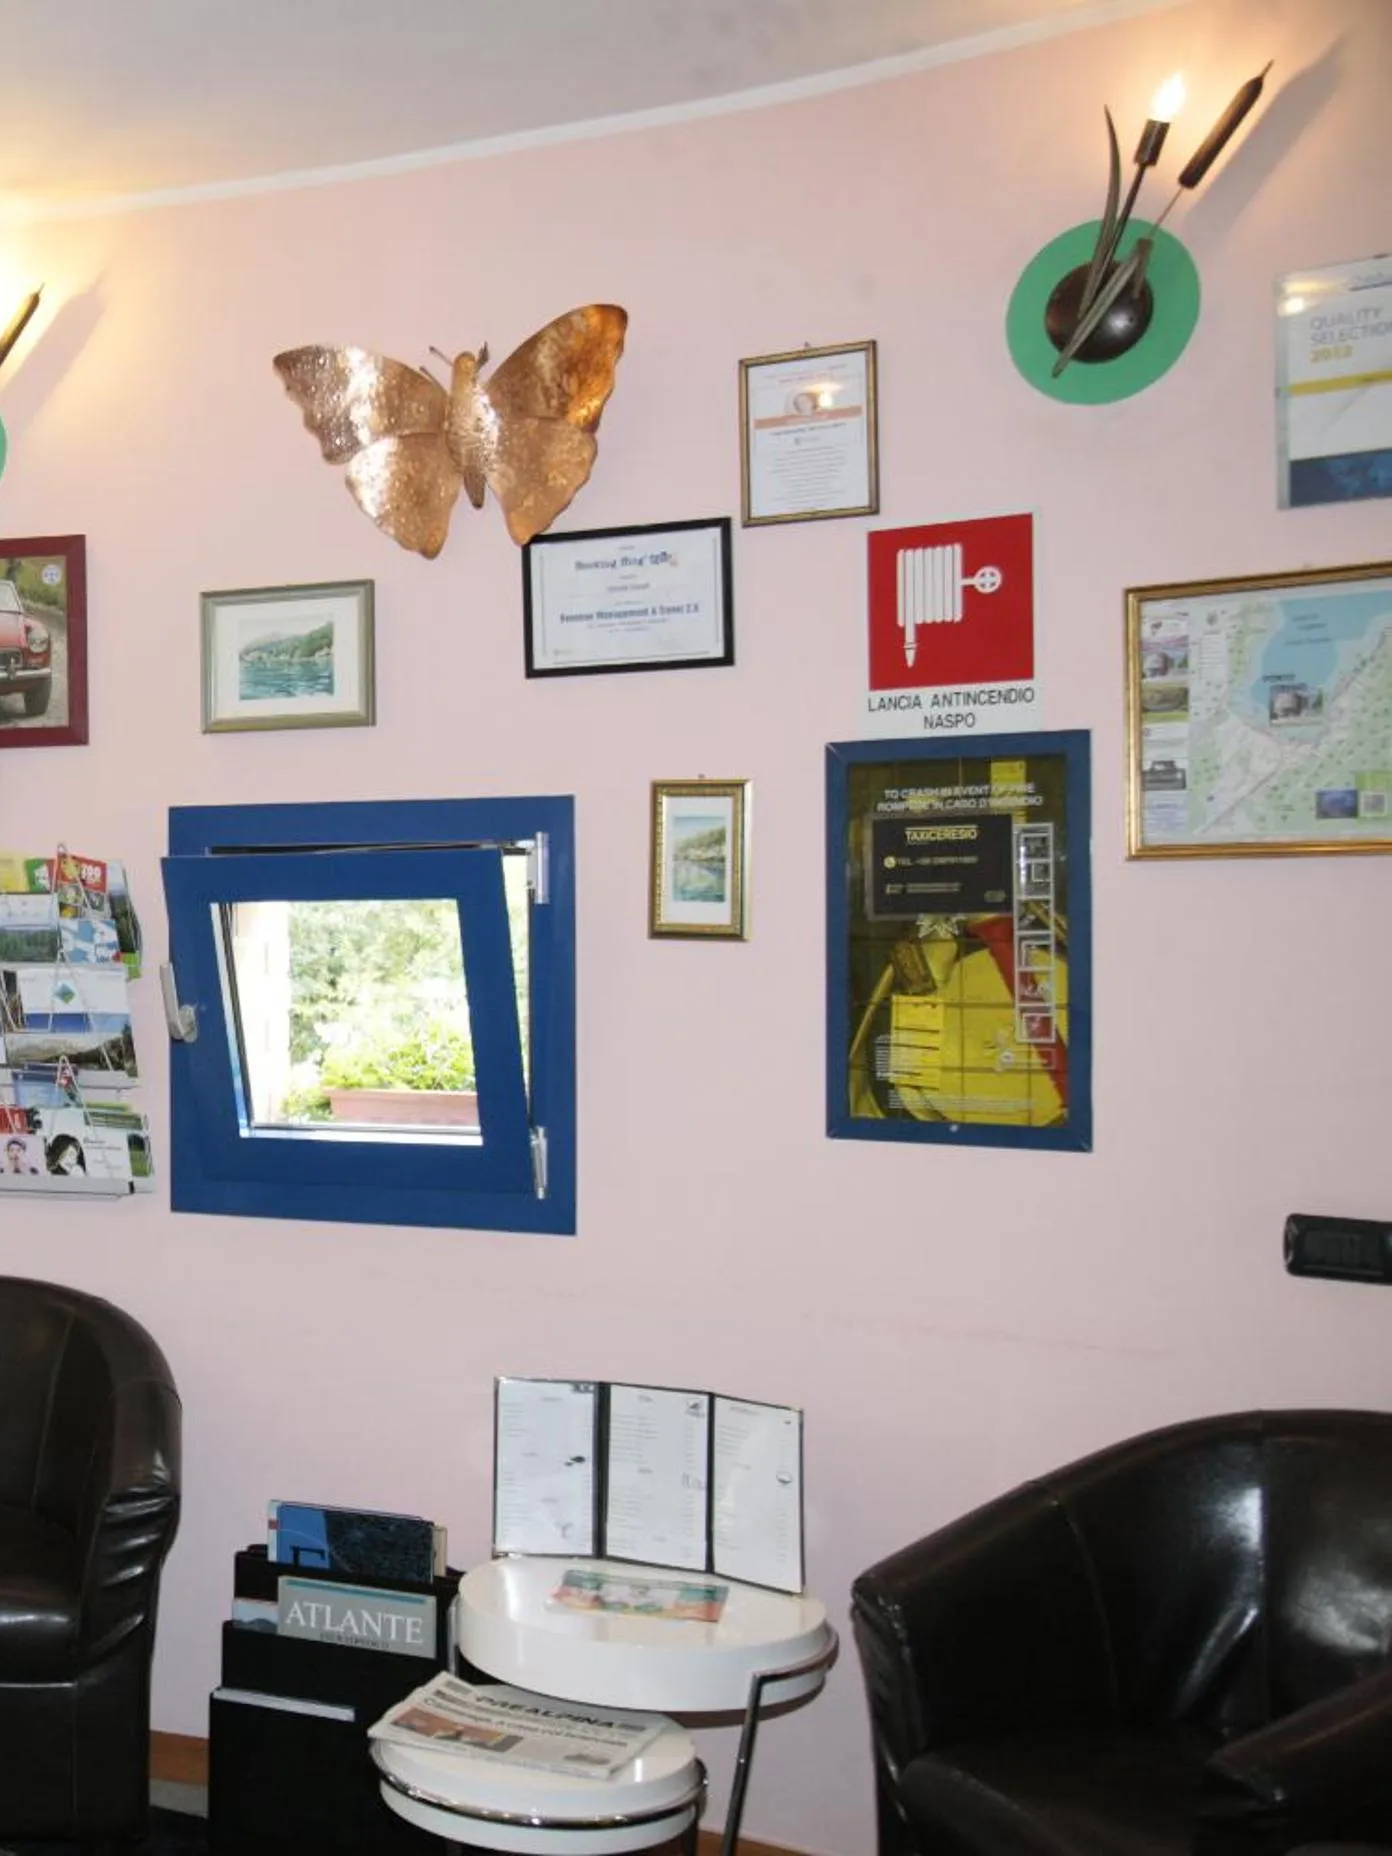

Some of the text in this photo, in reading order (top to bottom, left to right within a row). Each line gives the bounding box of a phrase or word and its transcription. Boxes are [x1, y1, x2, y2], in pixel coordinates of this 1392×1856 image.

[1310, 306, 1383, 331] QUALITY
[596, 607, 649, 620] Management
[868, 687, 1036, 712] LANCIA ANTINCENDIO
[923, 712, 976, 730] NASPO
[884, 789, 898, 800] TO
[285, 1601, 424, 1644] ATLANTE
